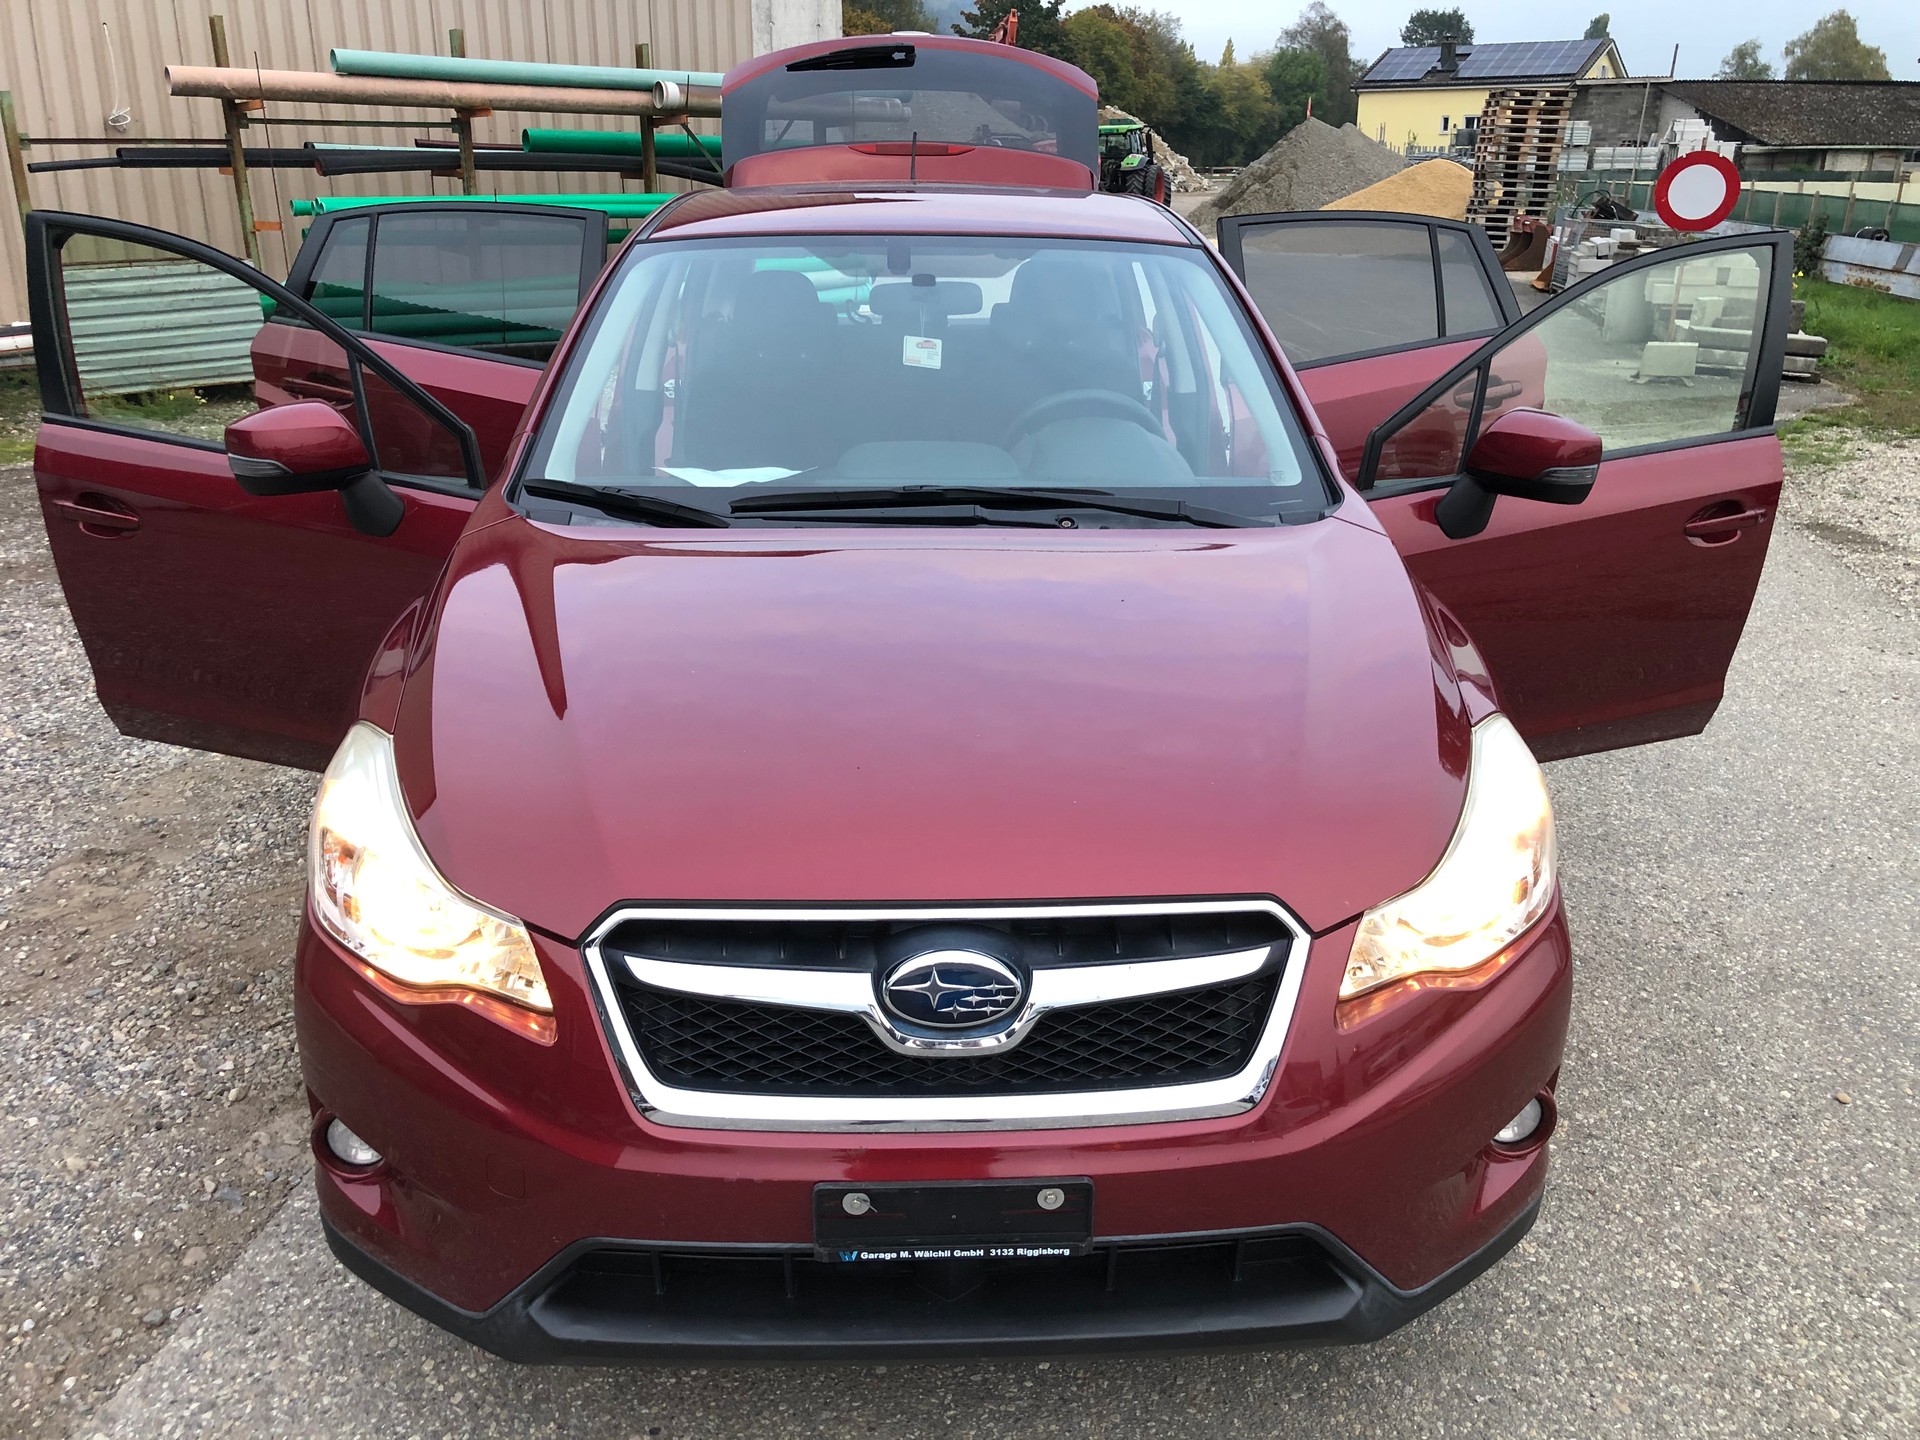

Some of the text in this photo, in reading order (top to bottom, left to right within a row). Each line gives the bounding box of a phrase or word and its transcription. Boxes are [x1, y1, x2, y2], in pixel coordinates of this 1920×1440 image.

[860, 1252, 898, 1260] Garage
[953, 1249, 984, 1257] GmbH
[989, 1248, 1014, 1256] 3132
[1016, 1248, 1070, 1256] Riggisberg
